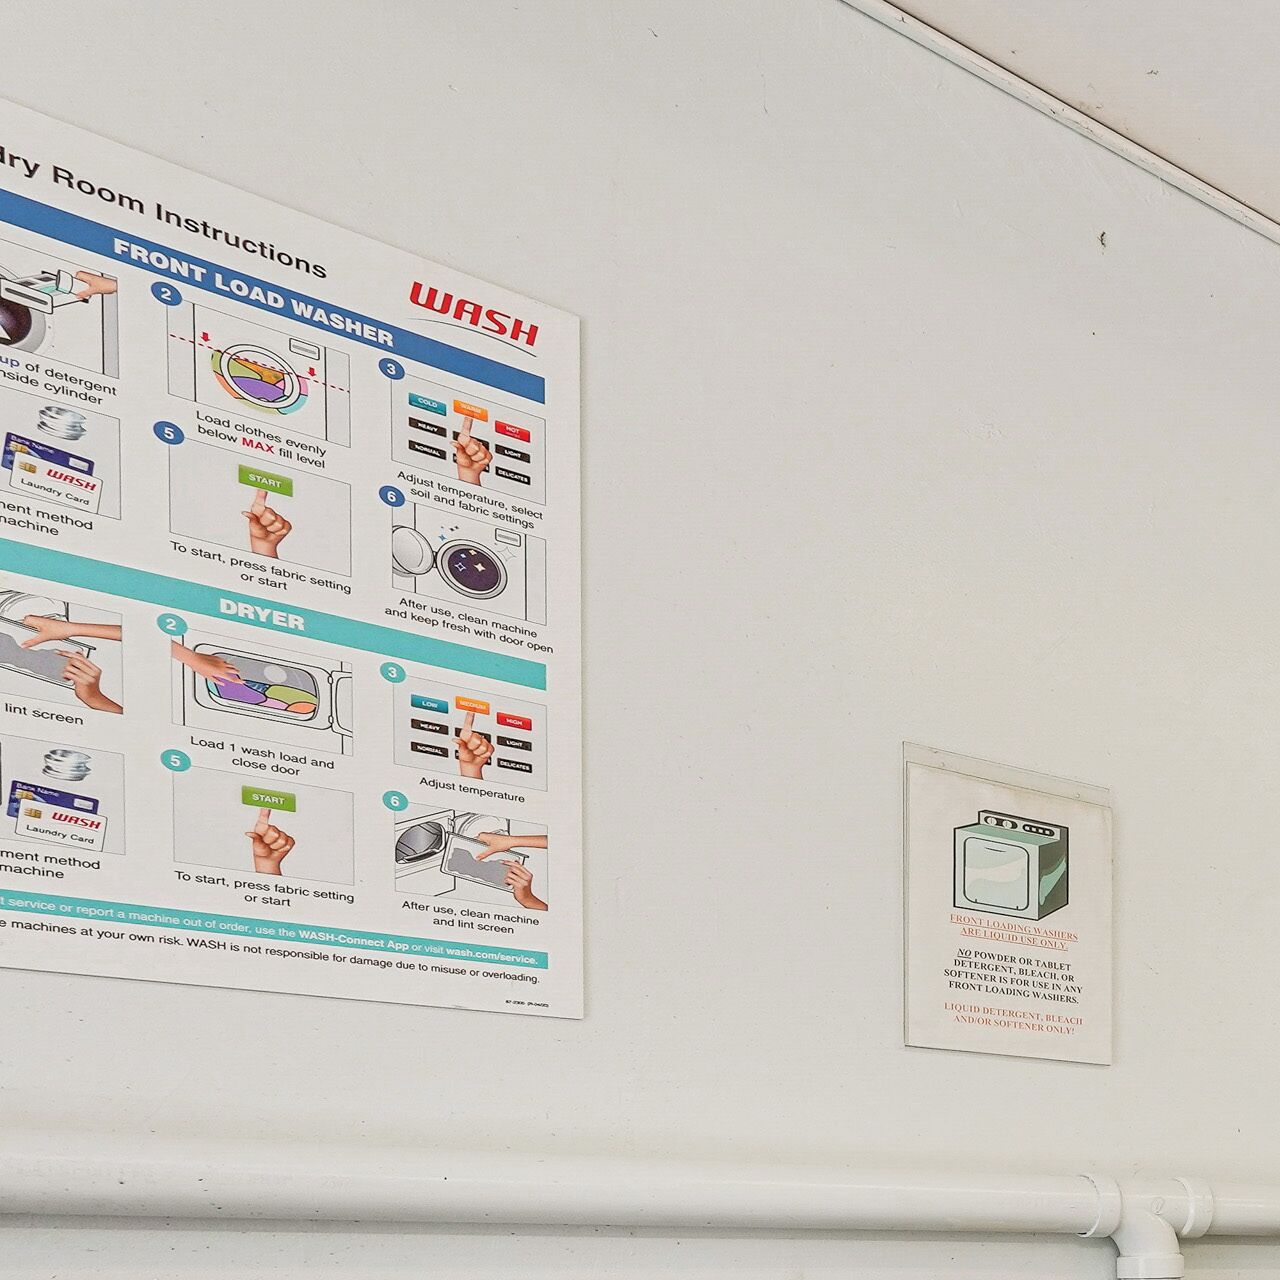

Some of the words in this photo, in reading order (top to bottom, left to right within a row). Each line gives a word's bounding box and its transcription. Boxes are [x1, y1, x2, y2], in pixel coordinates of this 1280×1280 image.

[52, 164, 145, 215] Room
[156, 203, 328, 279] Instructions
[113, 237, 207, 283] FRONT
[214, 272, 286, 309] LOAD
[291, 299, 394, 347] WASHER
[409, 281, 539, 347] WASH
[196, 410, 231, 430] Load
[234, 421, 282, 445] clothes
[285, 436, 327, 458] evenly
[198, 425, 238, 446] below
[241, 437, 275, 455] MAX
[279, 446, 294, 461] fill
[296, 451, 326, 469] level
[248, 473, 282, 489] START
[397, 471, 435, 489] Adjust
[437, 481, 509, 510] temperature,
[511, 504, 544, 520] select
[410, 487, 431, 500] soil
[433, 493, 455, 507] and
[458, 499, 490, 517] fabric
[492, 510, 535, 529] settings
[170, 540, 188, 553] To
[191, 544, 226, 564] start,
[230, 556, 267, 577] press
[270, 563, 308, 584] fabric
[310, 575, 352, 595] setting
[240, 572, 254, 582] or
[257, 575, 288, 591] start
[219, 598, 305, 631] DRYER
[385, 607, 407, 619] and
[410, 613, 439, 628] keep
[442, 620, 471, 635] fresh
[474, 627, 496, 640] with
[499, 633, 524, 647] door
[526, 641, 554, 654] open
[399, 597, 427, 611] After
[431, 606, 455, 619] use,
[458, 612, 488, 626] clean
[491, 621, 538, 639] machine
[190, 736, 224, 750] Load
[228, 742, 236, 752] 1
[241, 745, 276, 760] wash
[279, 750, 307, 765] load
[310, 754, 335, 770] and
[231, 757, 267, 772] close
[270, 763, 300, 777] door
[251, 793, 286, 805] START
[419, 777, 456, 792] Adjust
[459, 784, 526, 804] temperature
[953, 958, 1017, 975] DETERGENT,
[1018, 967, 1059, 981] BLEACH,
[1060, 973, 1075, 983] OR
[957, 948, 972, 959] NO
[974, 951, 1017, 964] POWDER
[1018, 956, 1033, 966] OR
[1035, 959, 1072, 972] TABLET
[943, 968, 997, 983] SOFTENER
[999, 975, 1009, 984] IS
[1010, 977, 1031, 986] FOR
[1032, 980, 1050, 989] USE
[1051, 982, 1062, 991] IN
[1063, 985, 1083, 994] ANY
[949, 981, 984, 993] FRONT
[985, 985, 1031, 999] LOADING
[1032, 991, 1079, 1004] WASHERS.
